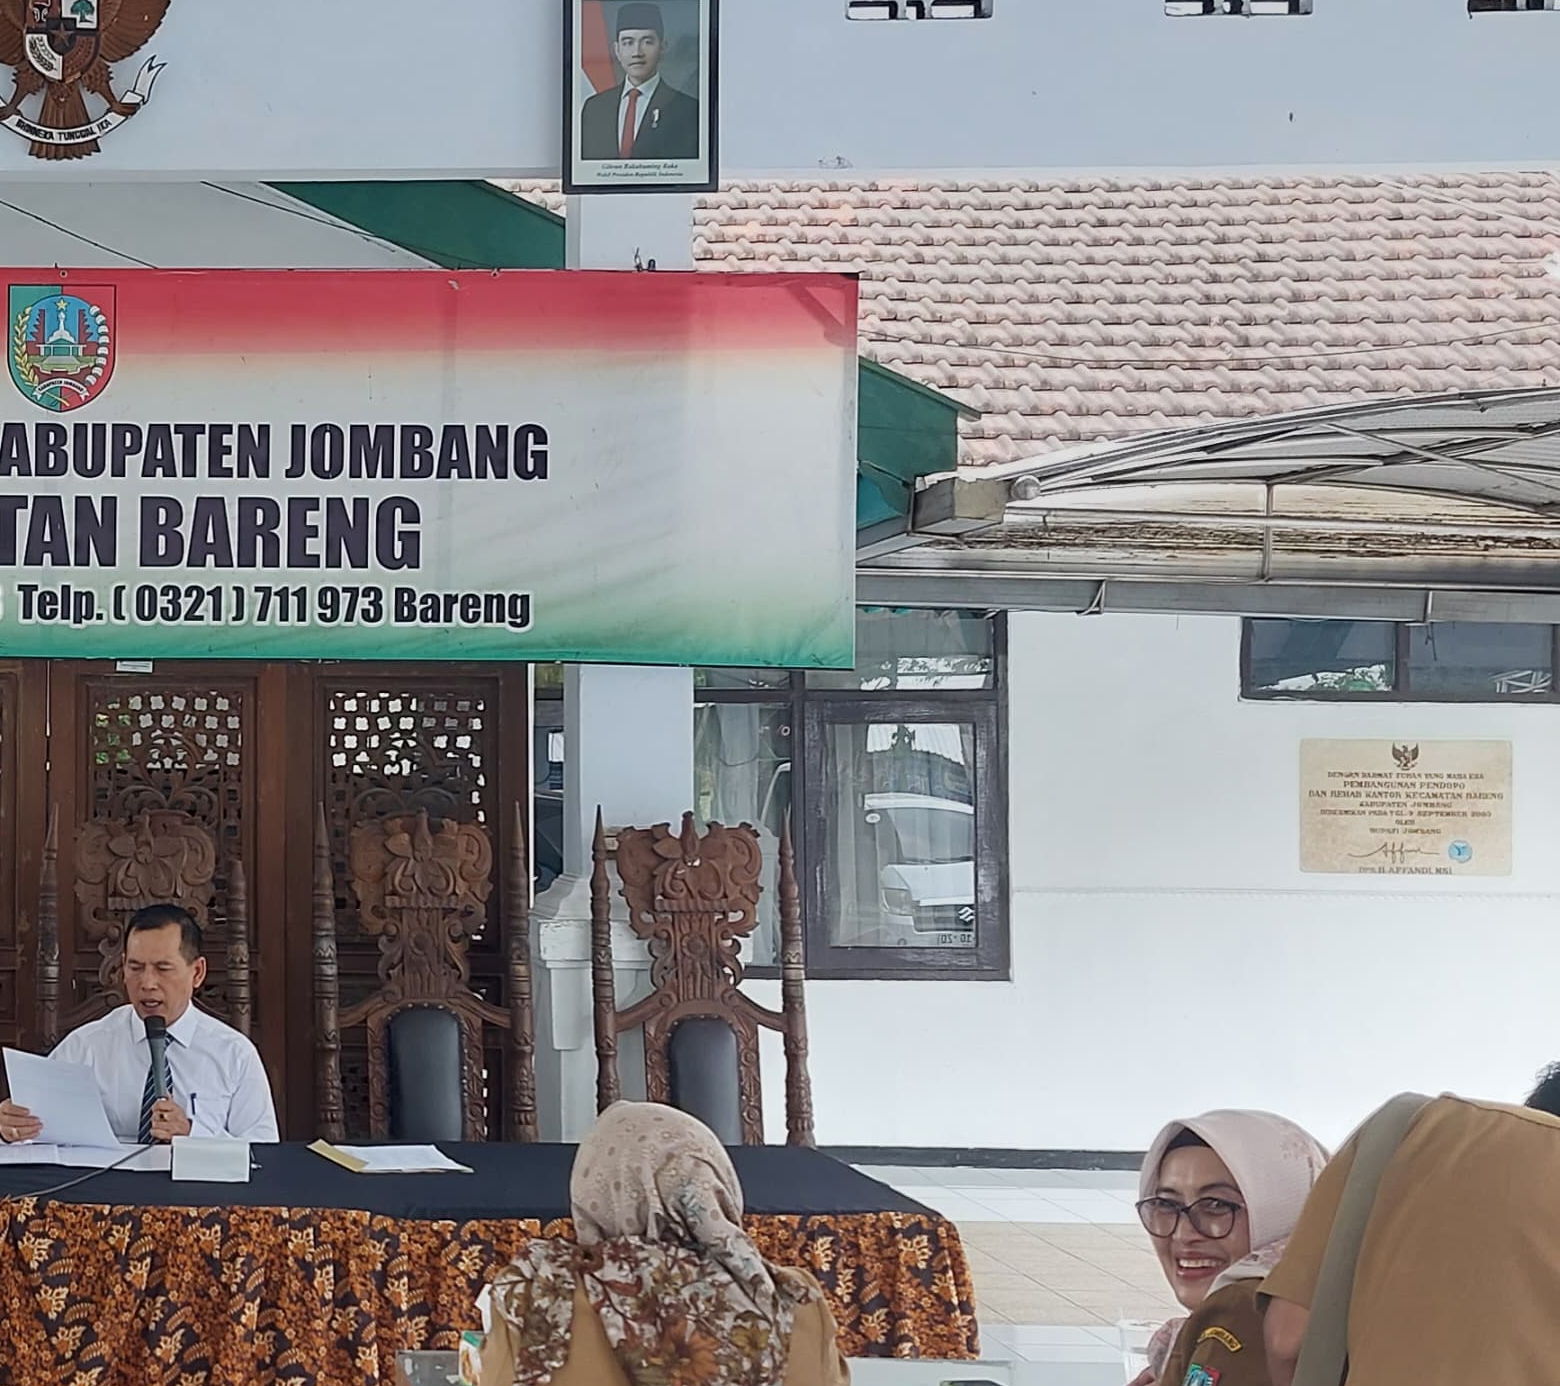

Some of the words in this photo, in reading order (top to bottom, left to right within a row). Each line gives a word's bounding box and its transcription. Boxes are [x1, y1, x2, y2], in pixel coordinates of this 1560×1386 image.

[284, 422, 550, 481] JOMBANG
[139, 495, 422, 571] BARENG
[17, 583, 104, 625] Telp.
[253, 585, 309, 623] 711
[317, 585, 385, 624] 973
[393, 586, 532, 628] Bareng
[1405, 791, 1463, 800] KECAMATAN
[1419, 781, 1466, 790] PENDOPO
